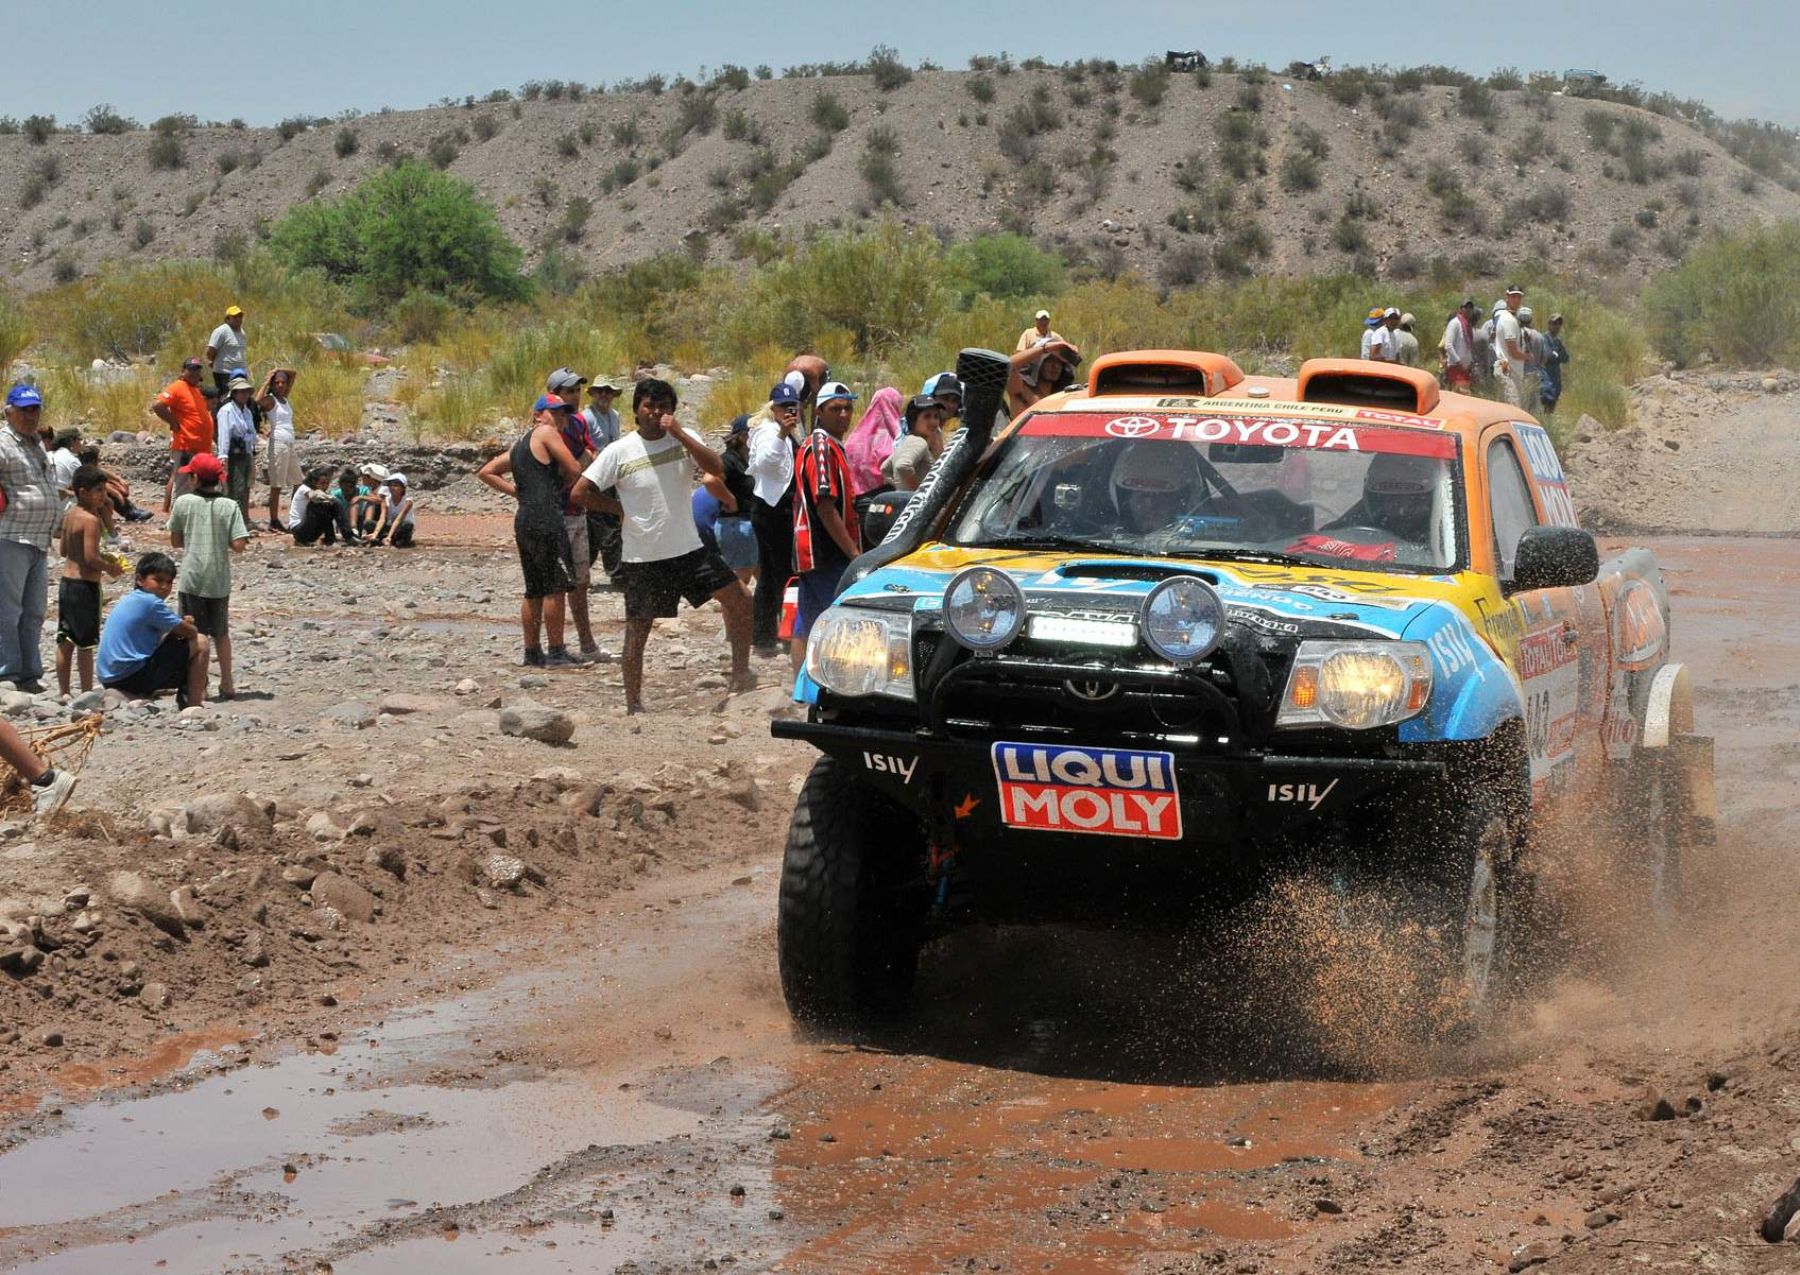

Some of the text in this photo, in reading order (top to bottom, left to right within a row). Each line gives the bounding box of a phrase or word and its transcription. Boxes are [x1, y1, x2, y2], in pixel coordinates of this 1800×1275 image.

[1202, 400, 1344, 414] ARGENTINA CHILE PERU
[1360, 411, 1439, 427] TOTAL
[1169, 417, 1361, 450] TOYOTA
[1003, 747, 1166, 789] LIQUI
[1012, 786, 1174, 832] MOLY
